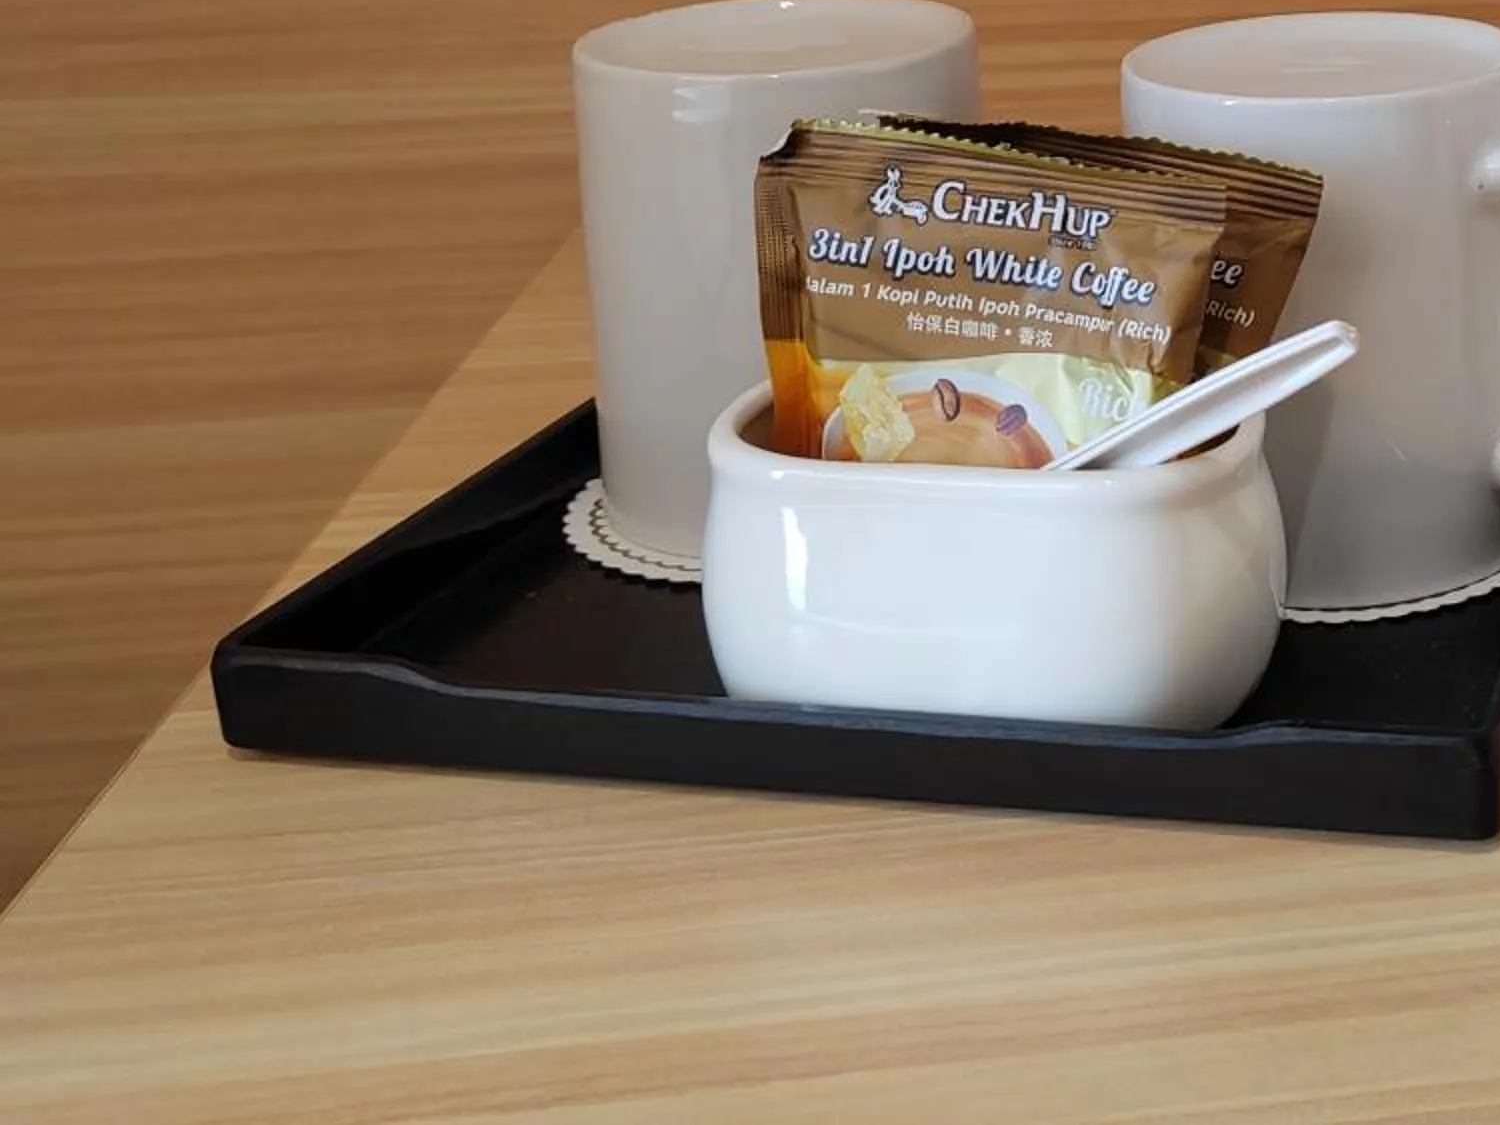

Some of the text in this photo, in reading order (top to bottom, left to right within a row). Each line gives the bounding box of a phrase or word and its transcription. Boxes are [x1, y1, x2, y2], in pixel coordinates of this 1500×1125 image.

[808, 227, 1156, 308] 3in1 Ipoh White Coffee
[862, 282, 872, 298] 1
[877, 284, 919, 306] Kopi
[923, 289, 973, 310] Putih
[977, 296, 1020, 316] Ipoh
[1117, 317, 1172, 344] (Rich)
[1205, 300, 1256, 328] Rich)
